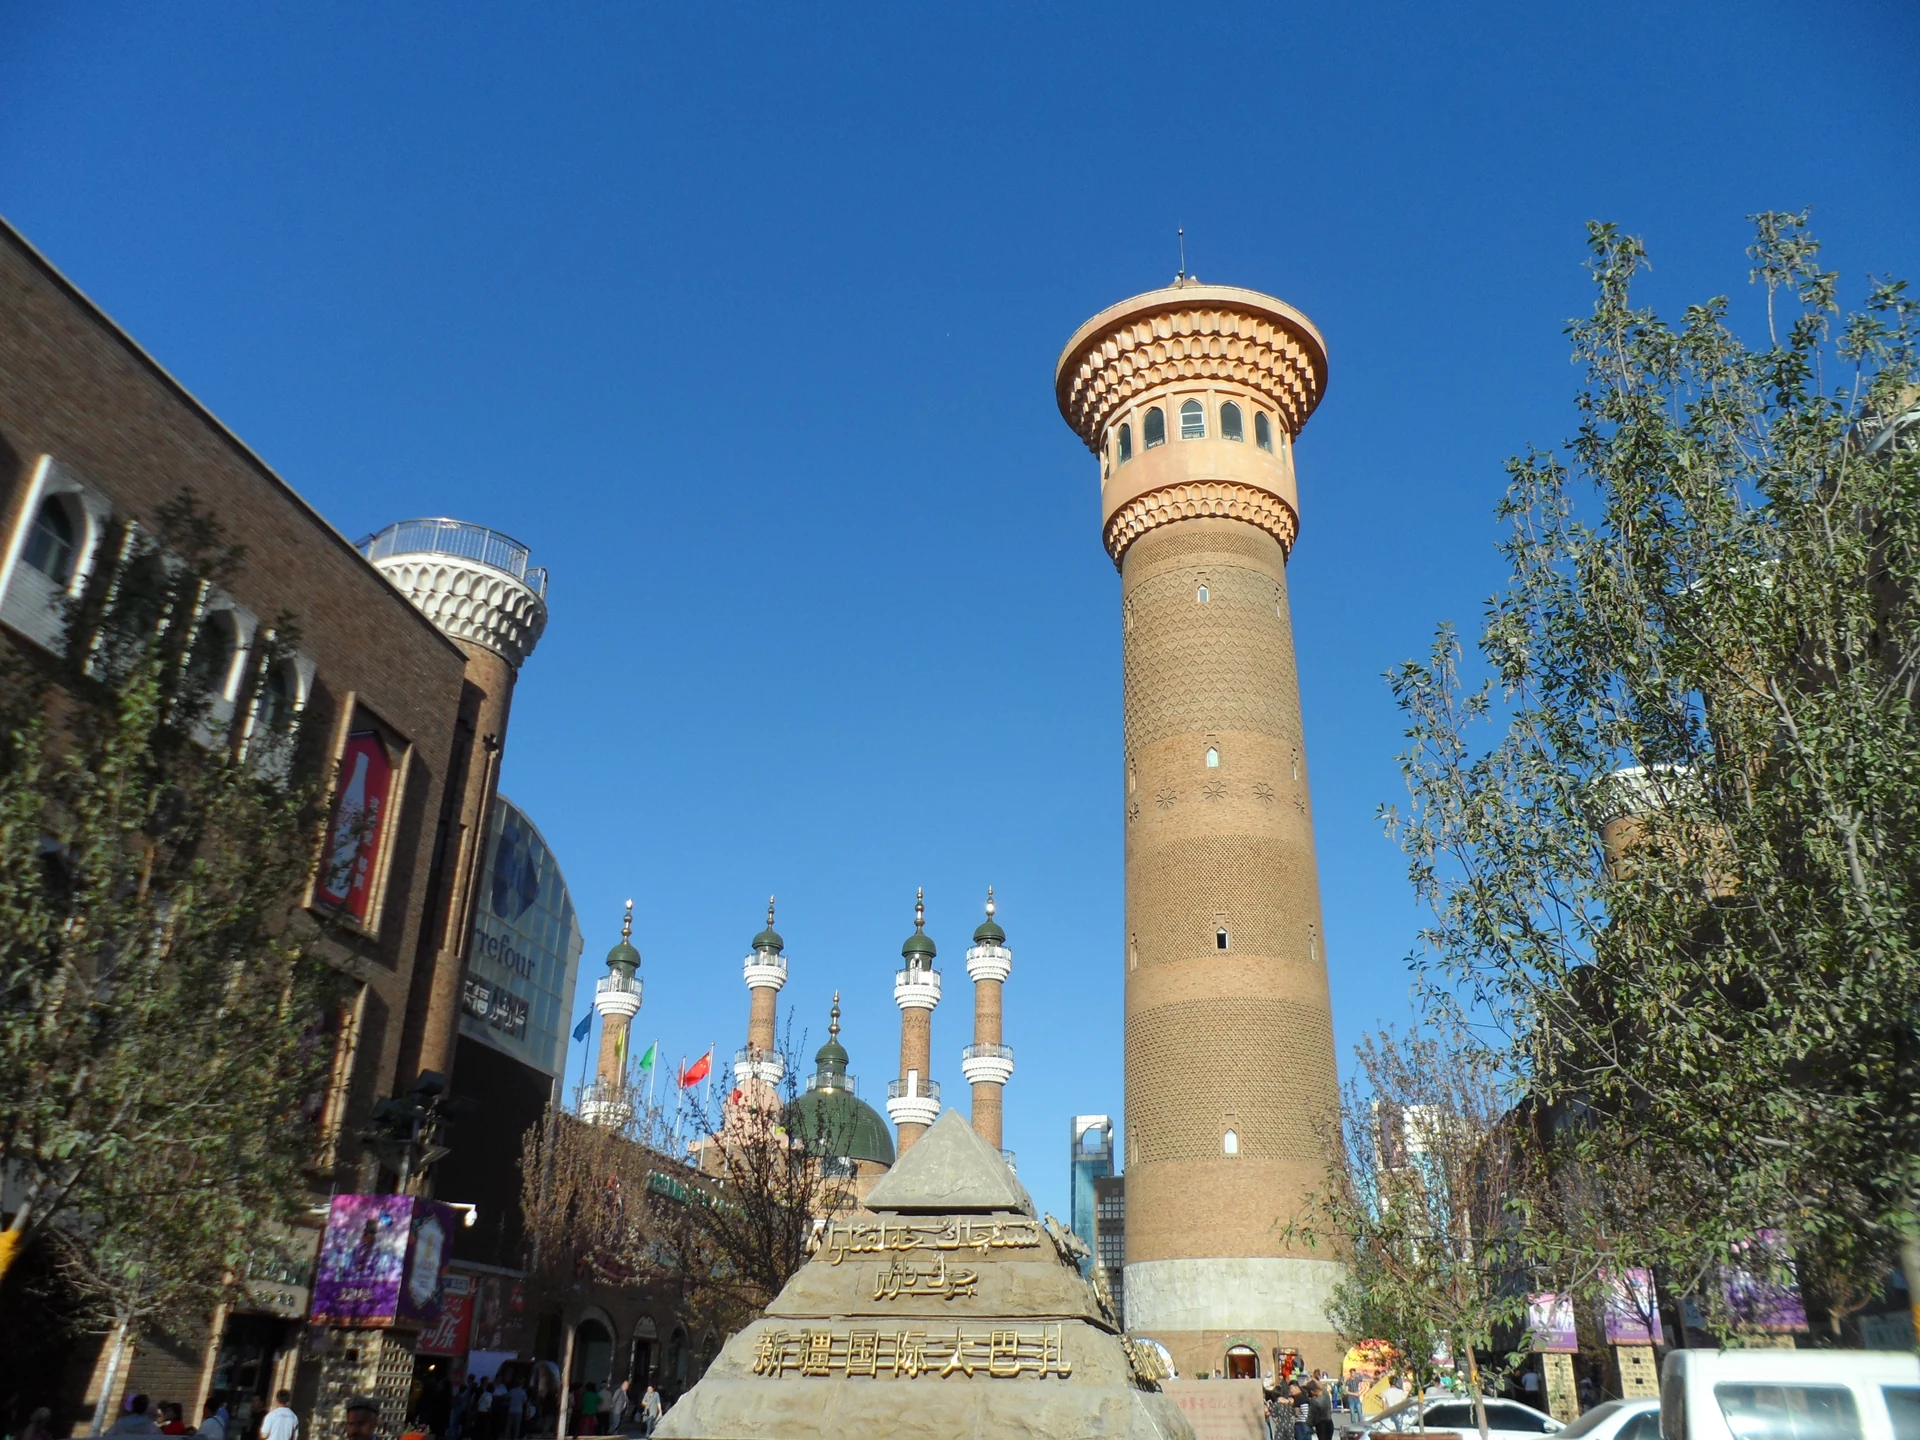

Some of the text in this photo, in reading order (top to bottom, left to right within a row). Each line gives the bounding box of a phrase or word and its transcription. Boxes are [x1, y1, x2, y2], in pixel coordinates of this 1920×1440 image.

[753, 1323, 1073, 1379] 新疆国际大巴扎
